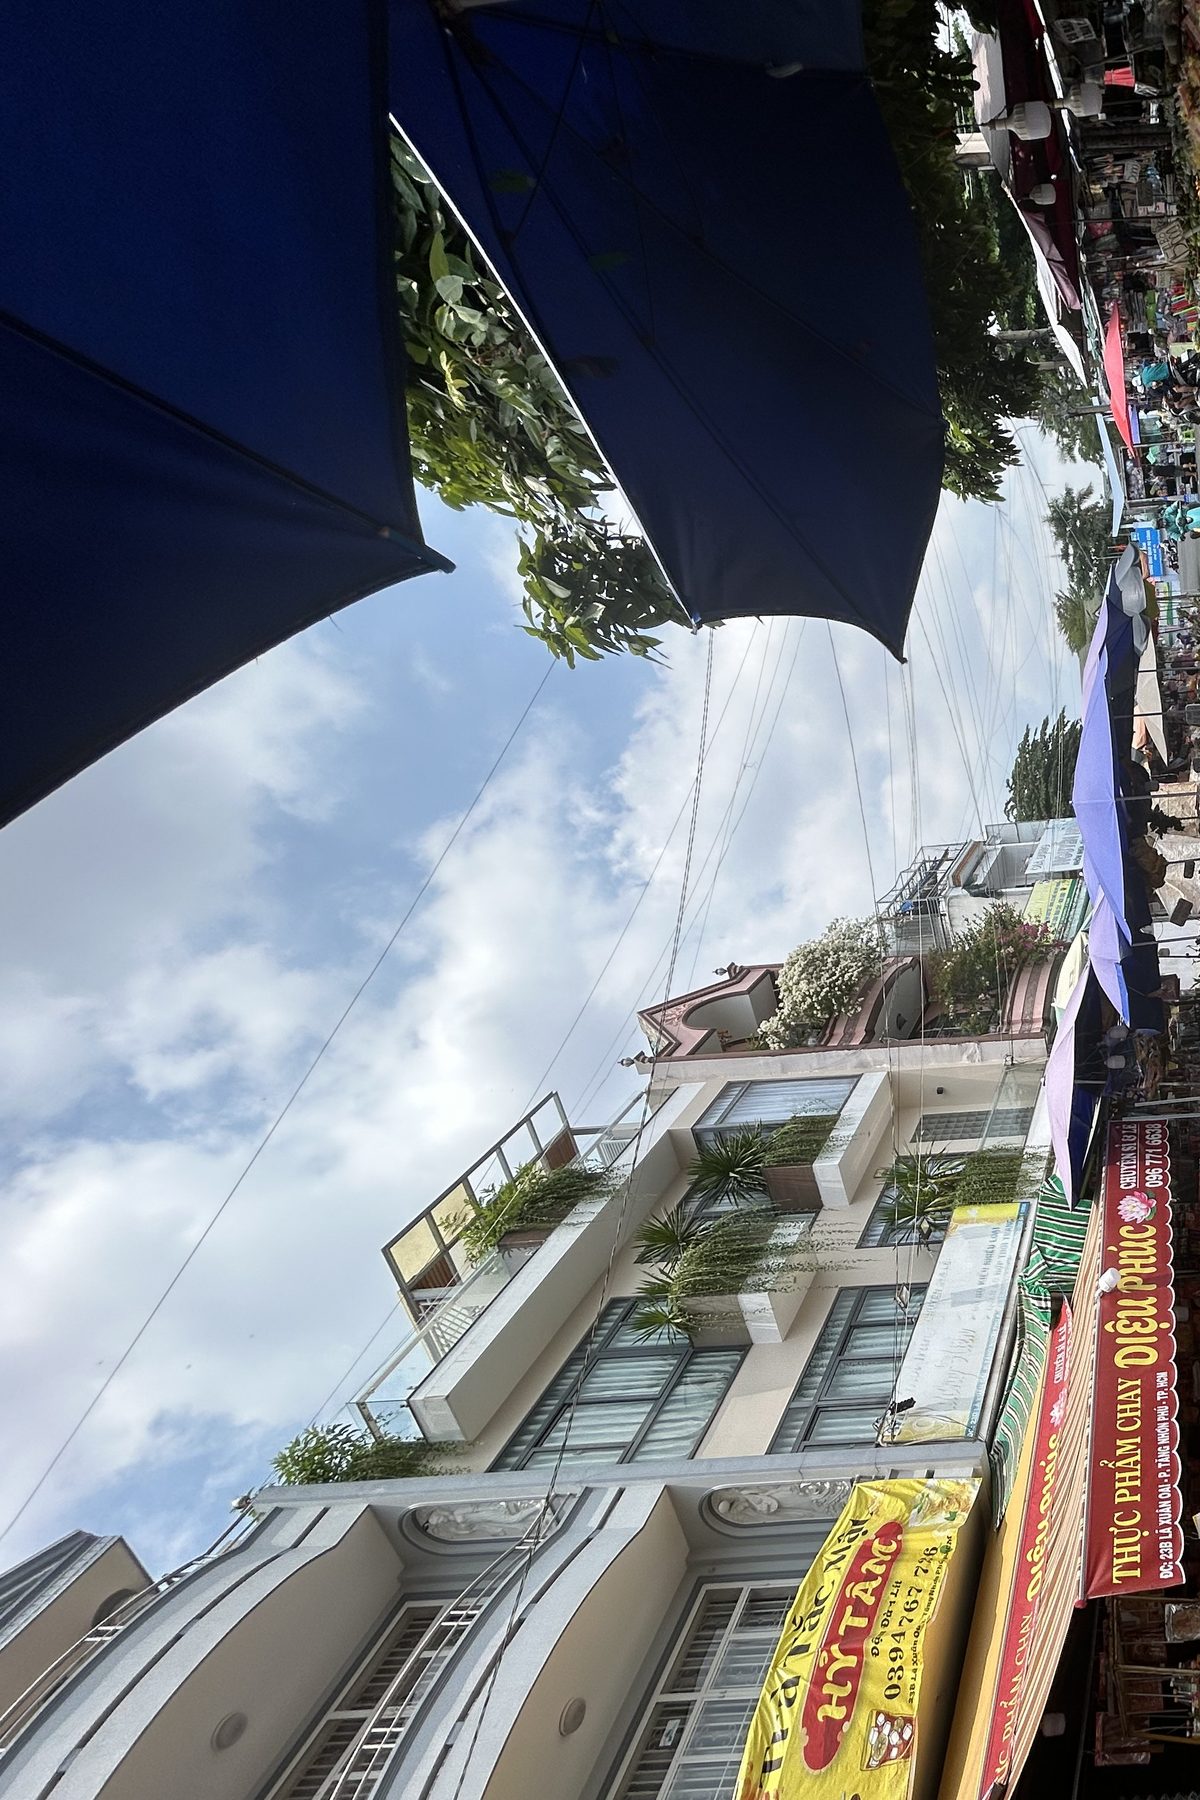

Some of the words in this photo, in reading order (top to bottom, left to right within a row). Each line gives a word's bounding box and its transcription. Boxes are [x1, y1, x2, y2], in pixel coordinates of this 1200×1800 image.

[1144, 1124, 1162, 1146] 6638
[1116, 1152, 1136, 1190] CHUYÊN
[1145, 1148, 1162, 1166] 771
[1144, 1168, 1164, 1188] 096
[1107, 1224, 1158, 1293] PHÚC
[1104, 1296, 1171, 1369] DIỆU
[1156, 1372, 1168, 1388] HCM
[1116, 1377, 1142, 1432] CHAY
[1154, 1406, 1170, 1421] PHÚ
[1099, 1436, 1142, 1505] PHẨM
[1158, 1484, 1172, 1499] OAI
[1155, 1500, 1172, 1526] XUÂN
[1108, 1509, 1150, 1584] THỰC
[1159, 1542, 1173, 1560] 23B
[838, 1535, 896, 1636] TÂM
[883, 1630, 906, 1700] 0394
[898, 1586, 922, 1627] 767
